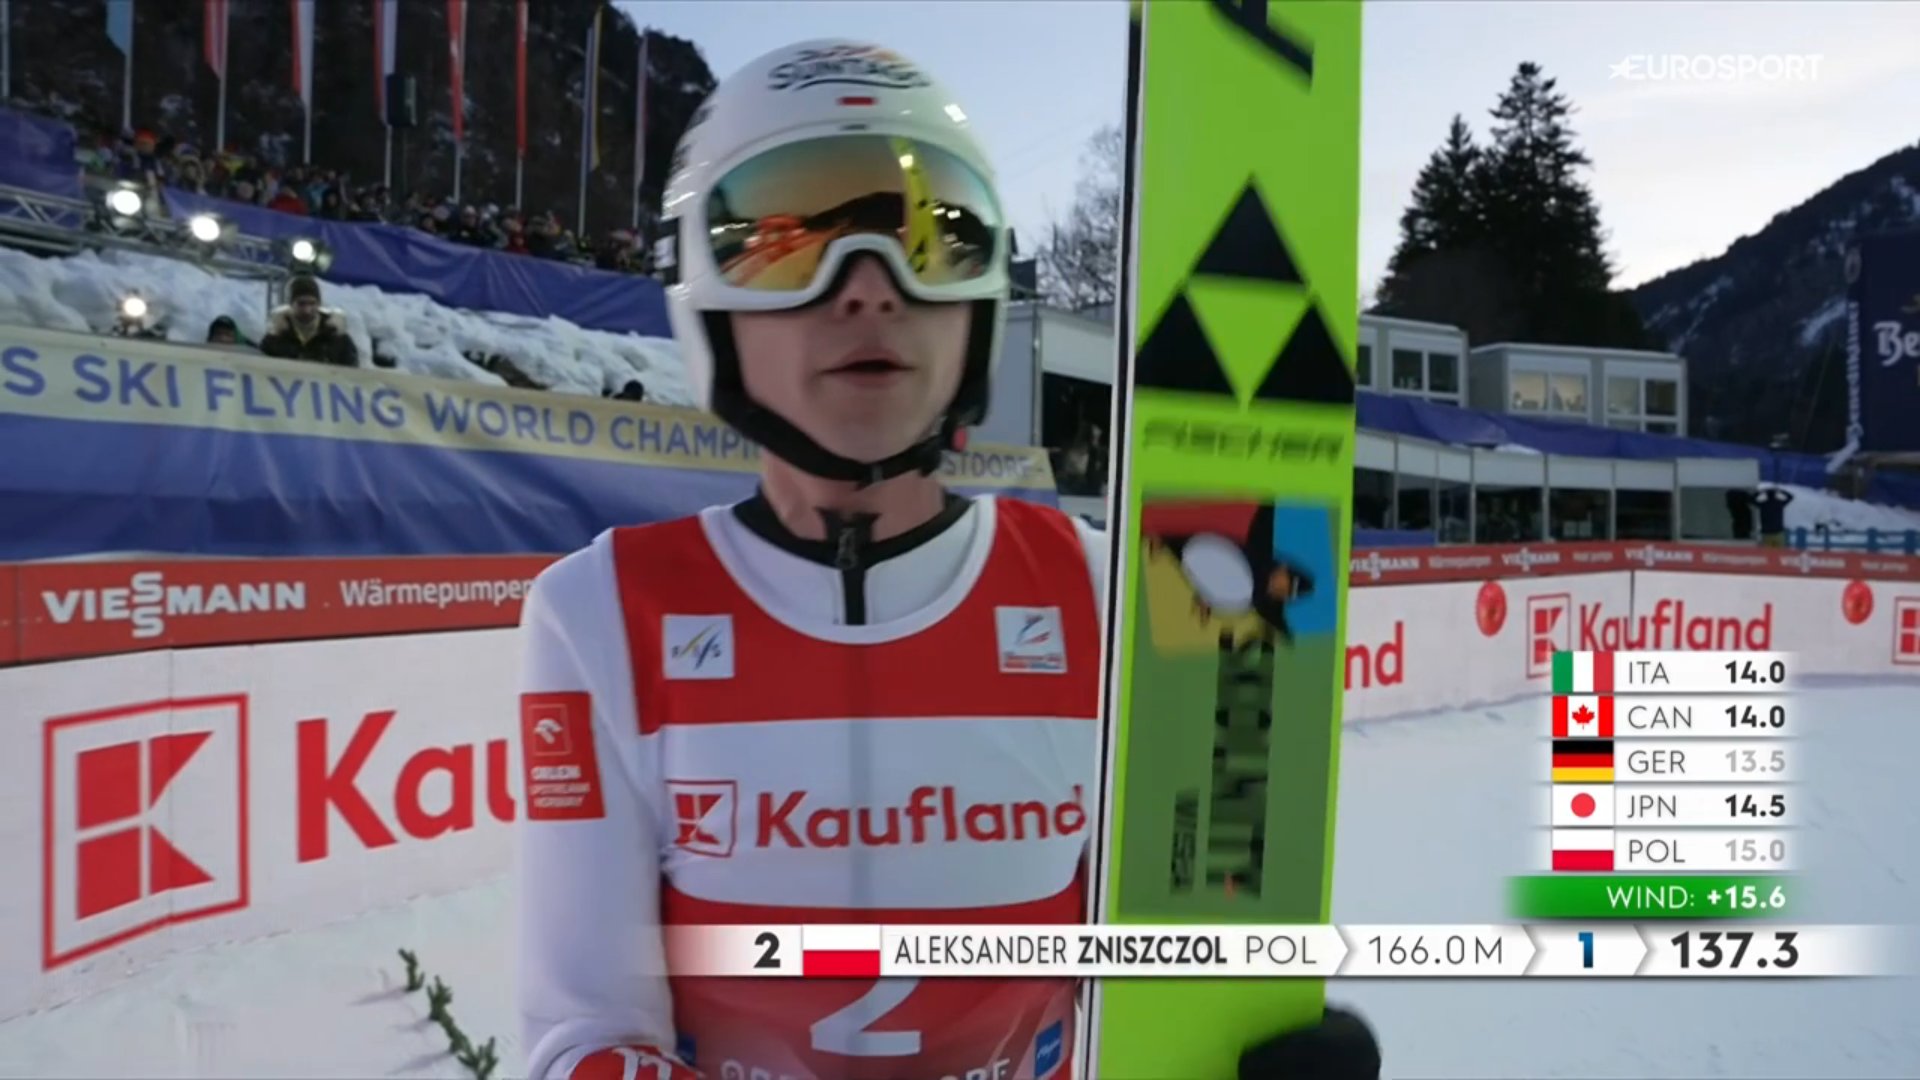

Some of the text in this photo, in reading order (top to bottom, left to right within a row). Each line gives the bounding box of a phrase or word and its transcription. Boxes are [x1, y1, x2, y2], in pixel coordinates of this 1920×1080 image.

[73, 354, 181, 408] SKI
[204, 369, 405, 428] FLYING
[424, 392, 595, 446] WORLD
[41, 571, 306, 638] VIESSMANN
[1579, 599, 1772, 651] Kaufland
[756, 785, 1087, 847] Kaufland
